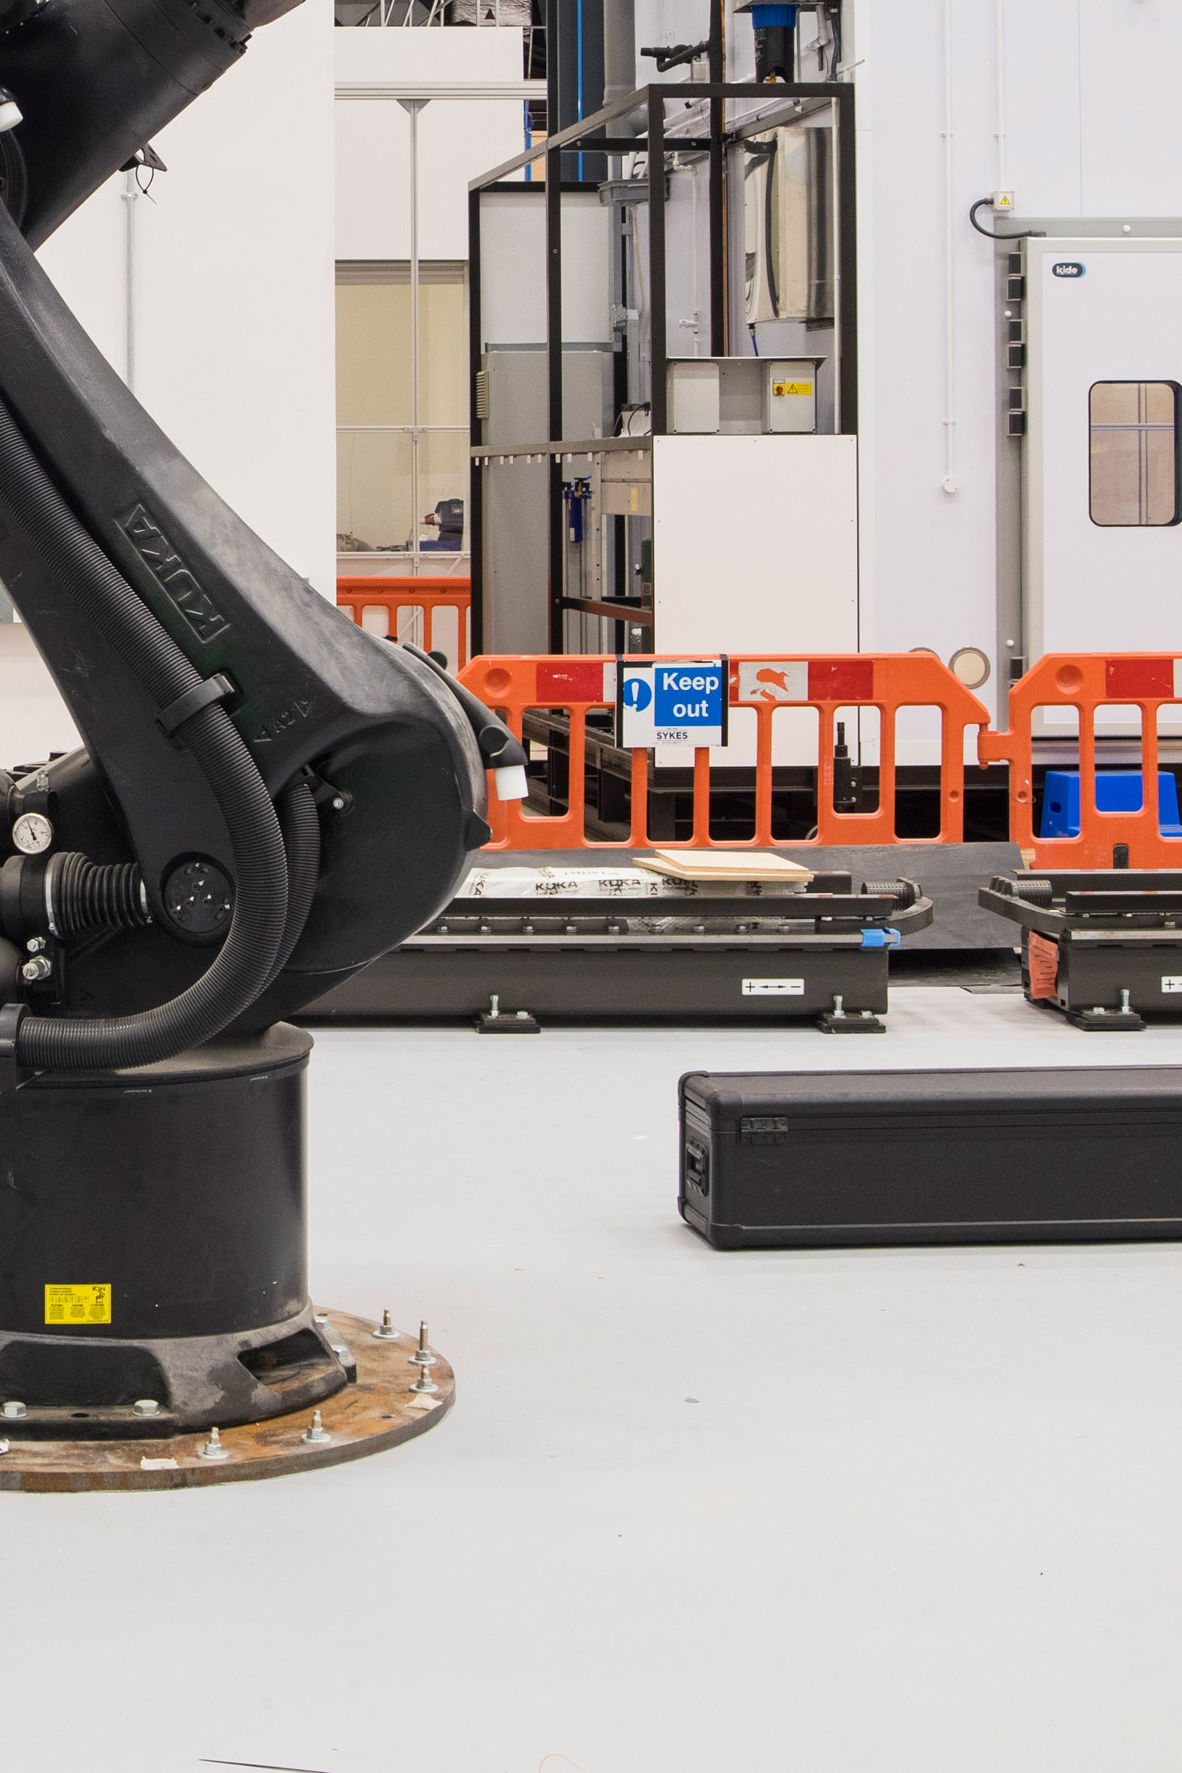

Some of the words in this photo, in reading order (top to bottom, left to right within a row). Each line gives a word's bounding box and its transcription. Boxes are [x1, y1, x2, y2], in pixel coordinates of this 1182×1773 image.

[124, 503, 227, 638] KUKA
[663, 672, 719, 695] Keep
[672, 700, 709, 718] out
[656, 731, 688, 740] SYKES
